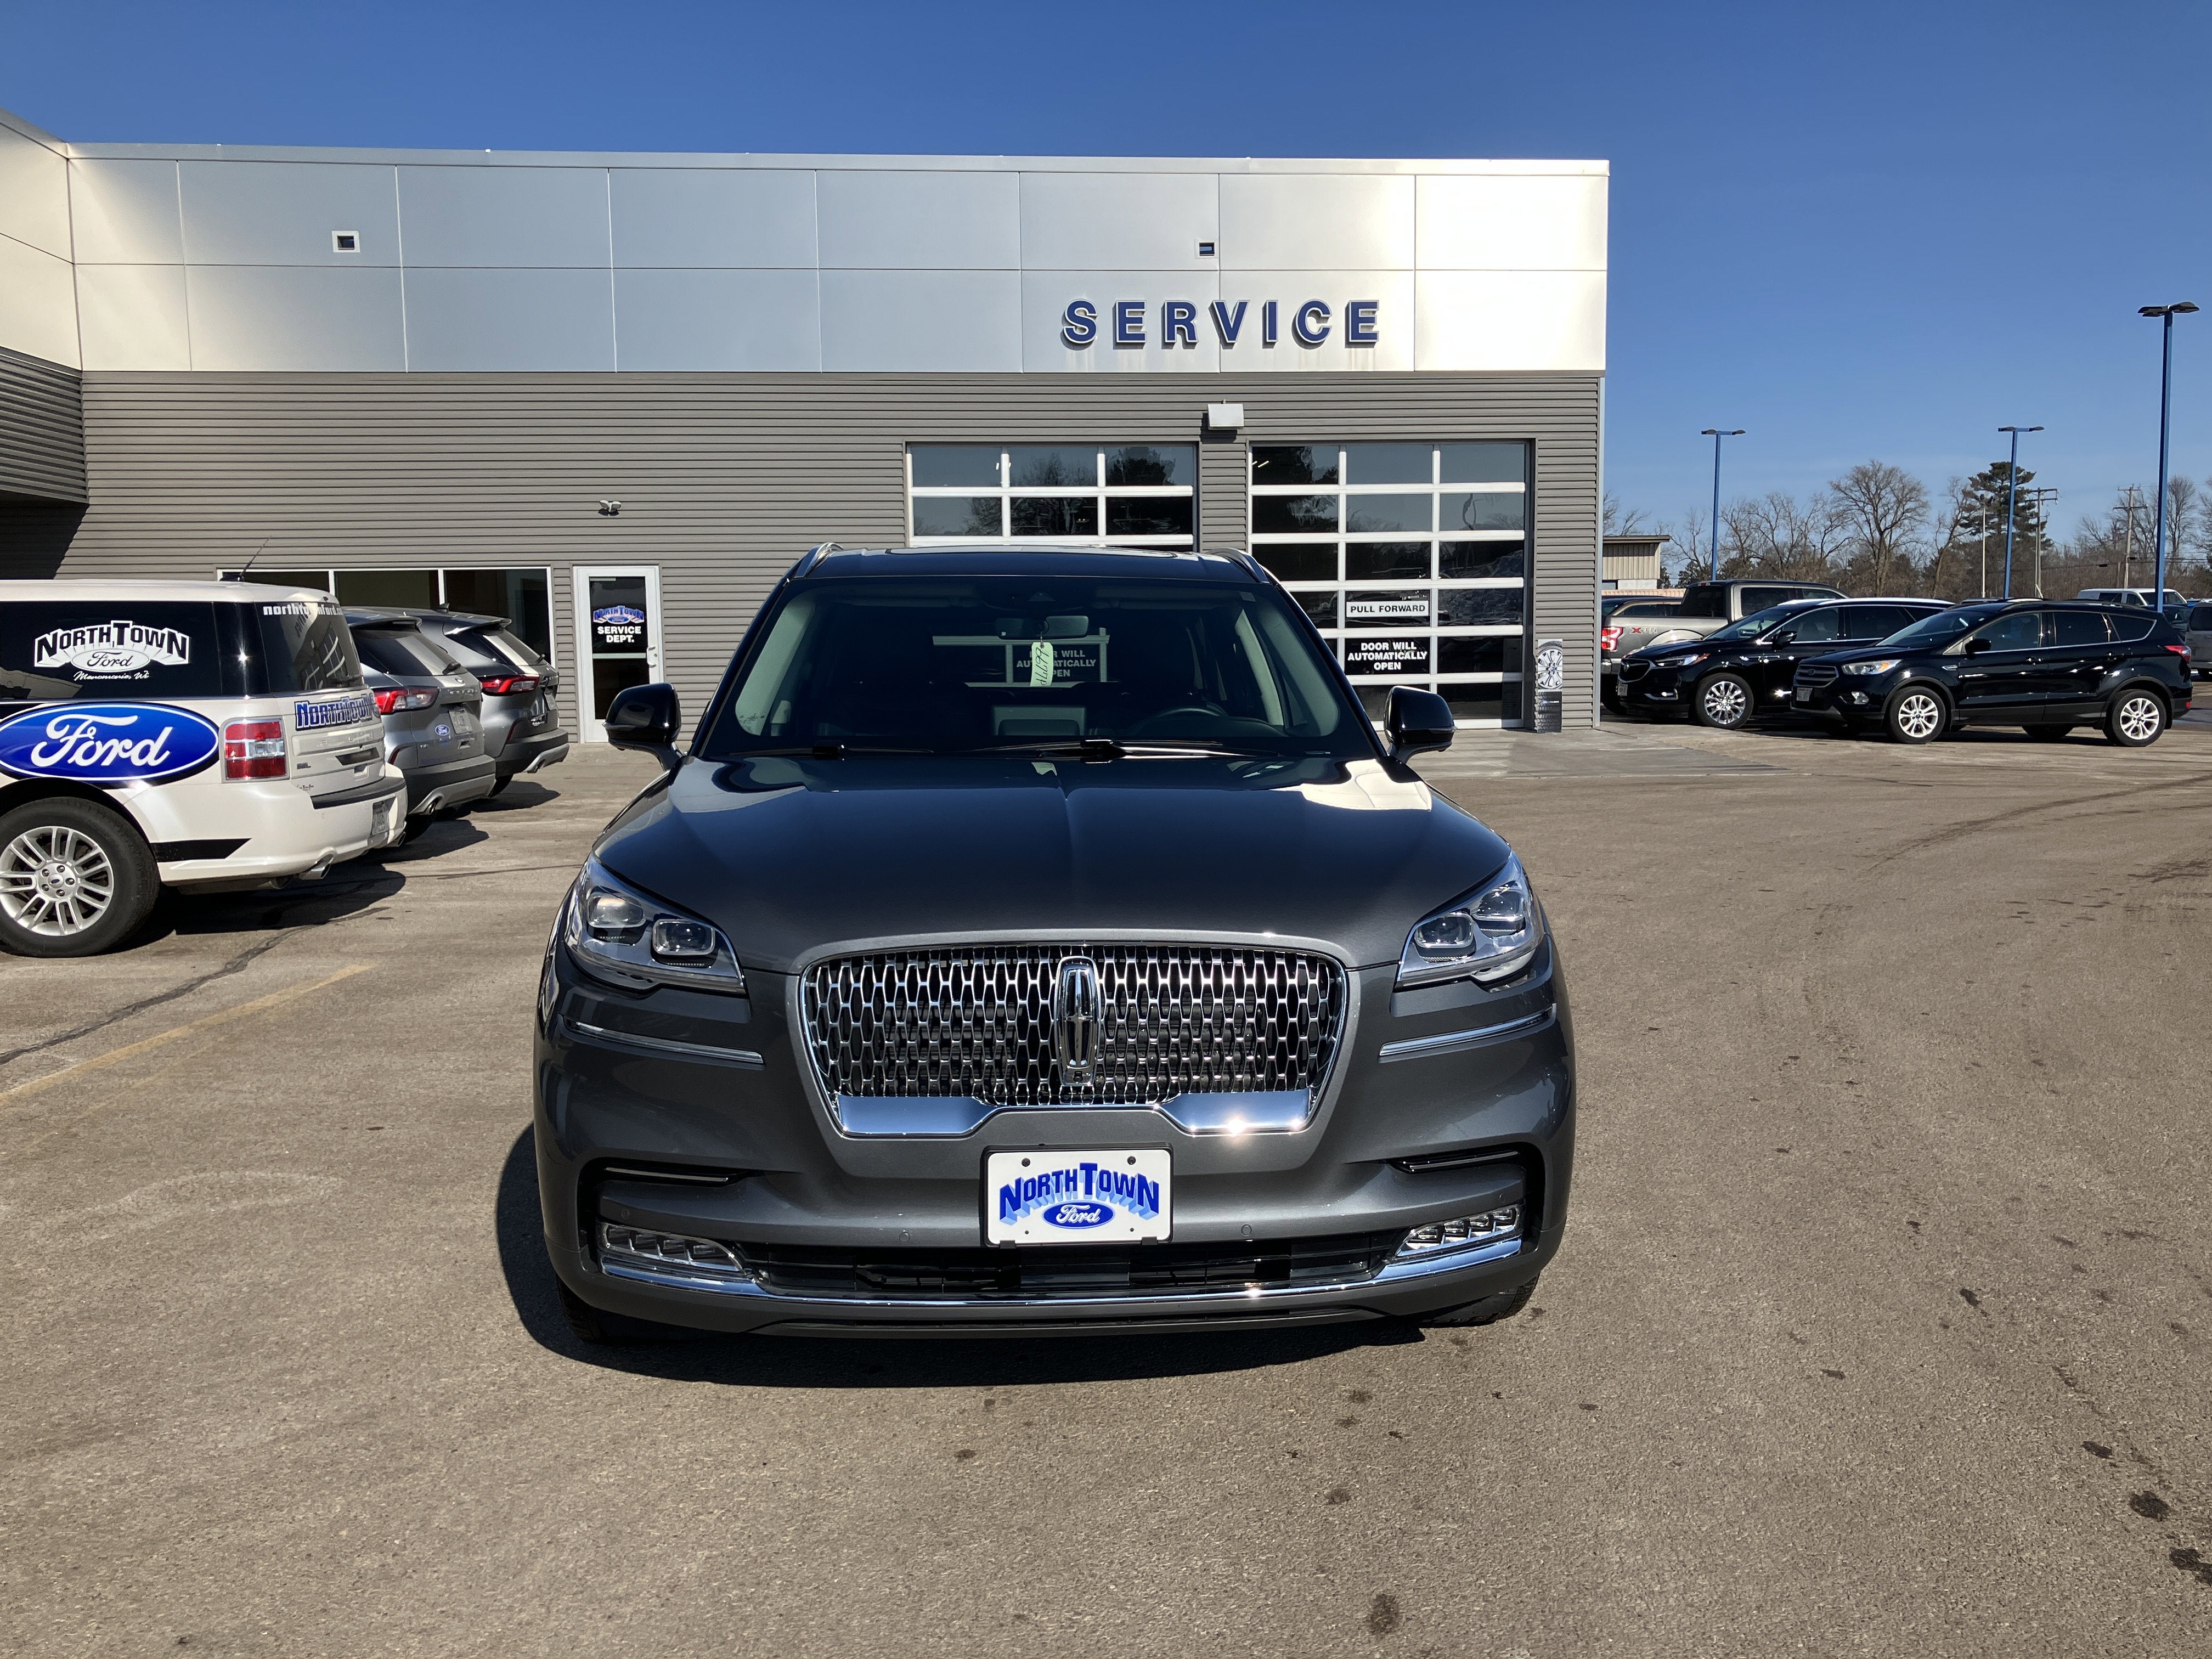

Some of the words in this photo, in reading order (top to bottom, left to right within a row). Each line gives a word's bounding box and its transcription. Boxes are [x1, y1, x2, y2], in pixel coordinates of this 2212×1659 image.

[1062, 299, 1379, 348] SERVICE
[597, 626, 641, 634] SERVICE
[1361, 642, 1389, 651] DOOR
[1392, 642, 1417, 650] WILL
[87, 651, 133, 667] Ford
[1062, 650, 1086, 658] WILL
[1347, 651, 1427, 661] AUTOMATICALLY
[1016, 659, 1097, 668] AUATICALLY
[1035, 647, 1049, 686] 6677P
[1374, 662, 1402, 670] OPEN
[30, 713, 174, 768] Ford
[1056, 1204, 1101, 1224] Ford
